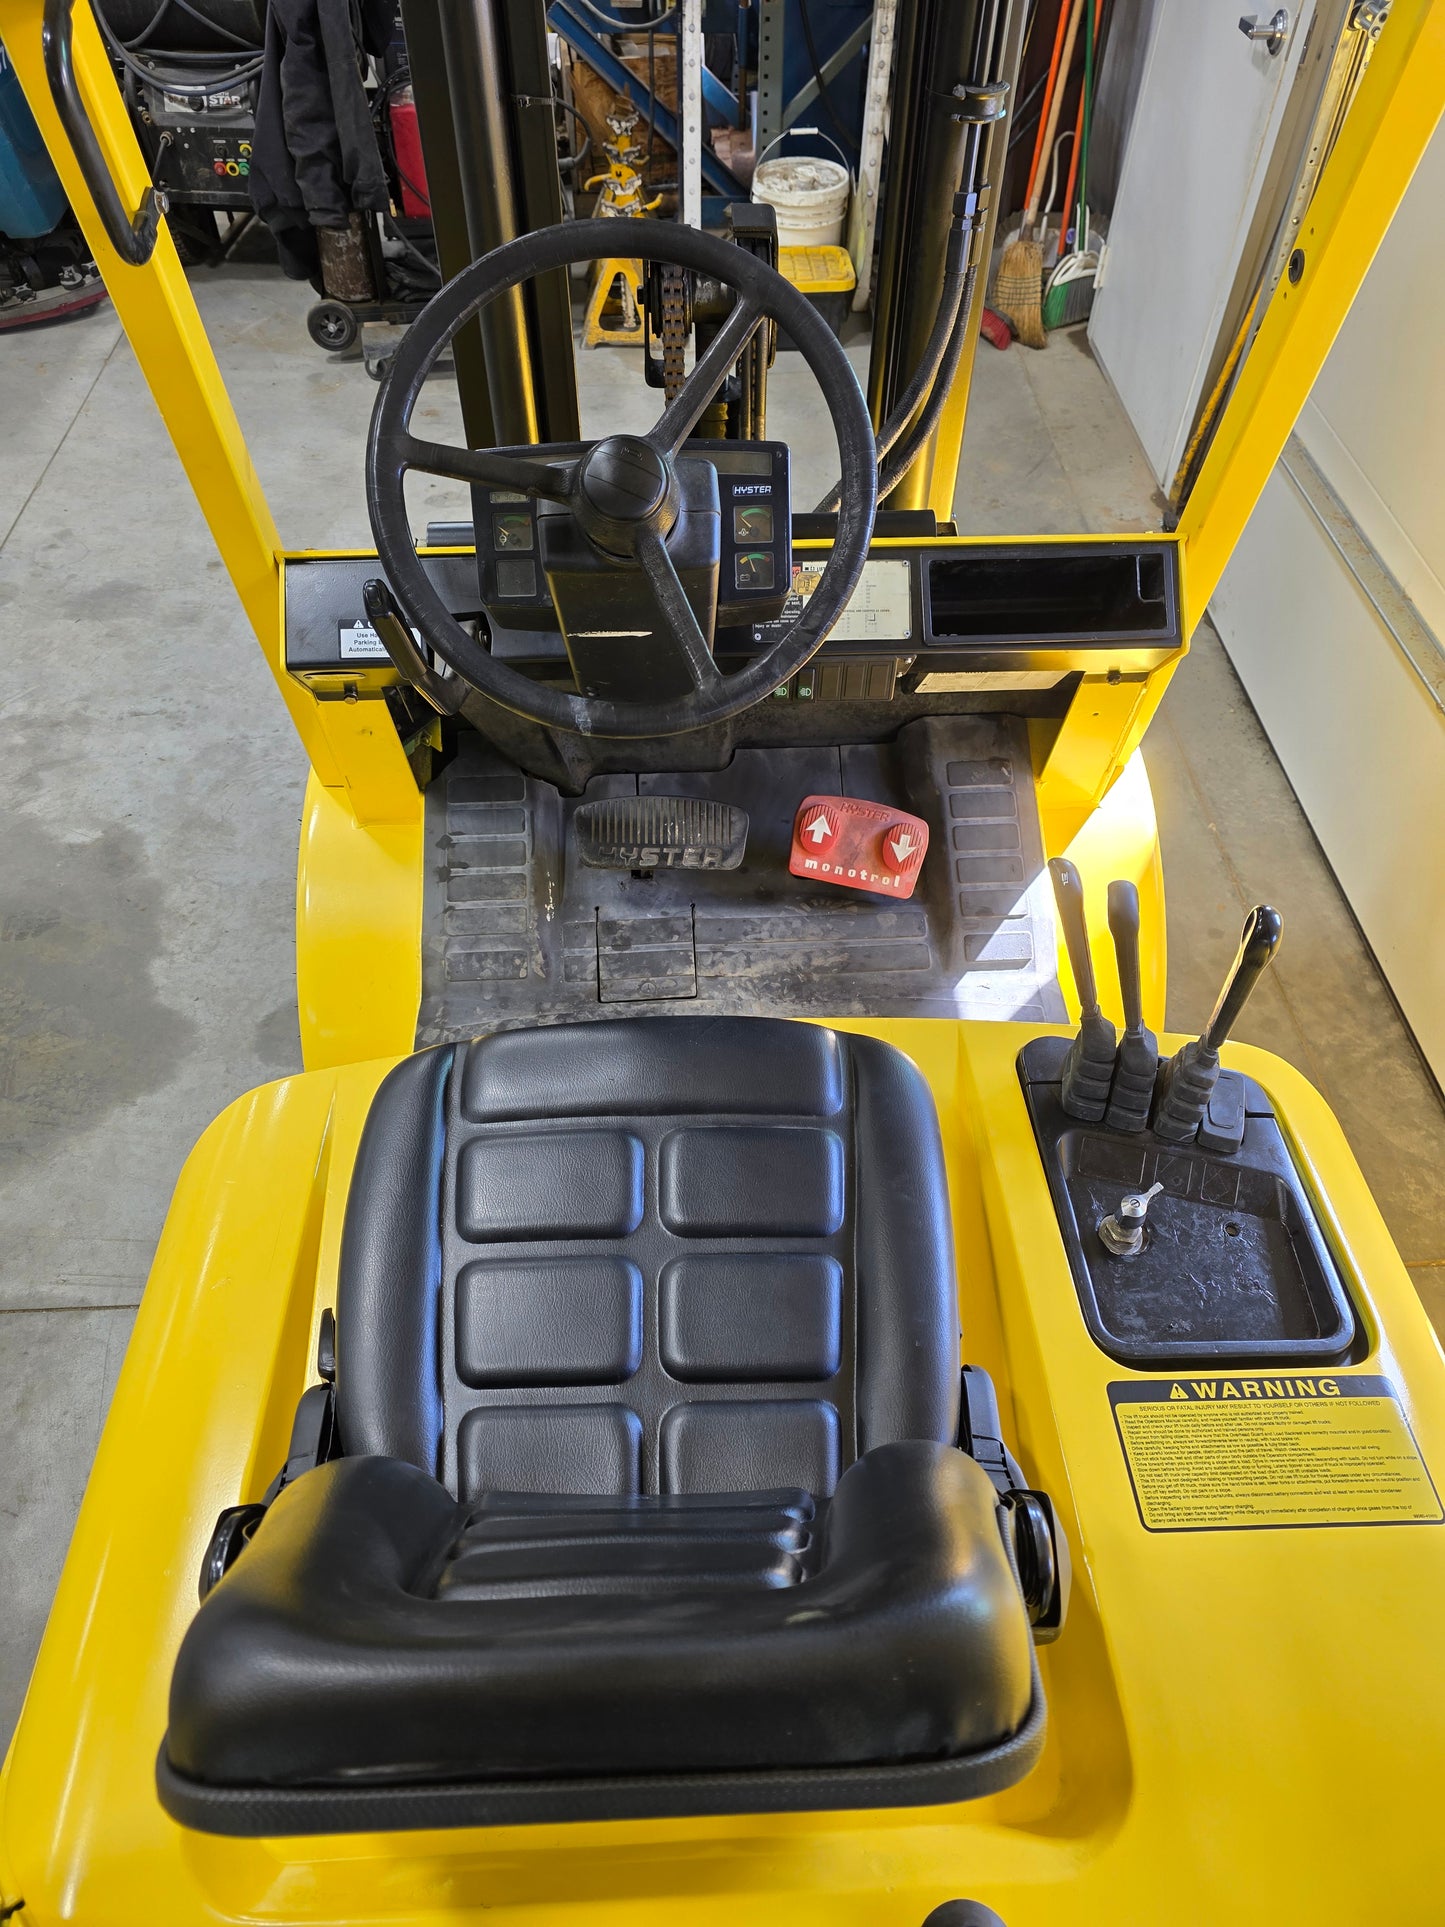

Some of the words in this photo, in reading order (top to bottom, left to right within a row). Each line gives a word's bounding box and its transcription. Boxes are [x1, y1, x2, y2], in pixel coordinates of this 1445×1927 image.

[209, 96, 241, 105] STAR
[734, 485, 772, 495] HYSTER
[839, 801, 892, 823] HYSTER
[804, 857, 901, 888] monotrol
[1190, 1378, 1341, 1401] WARNING
